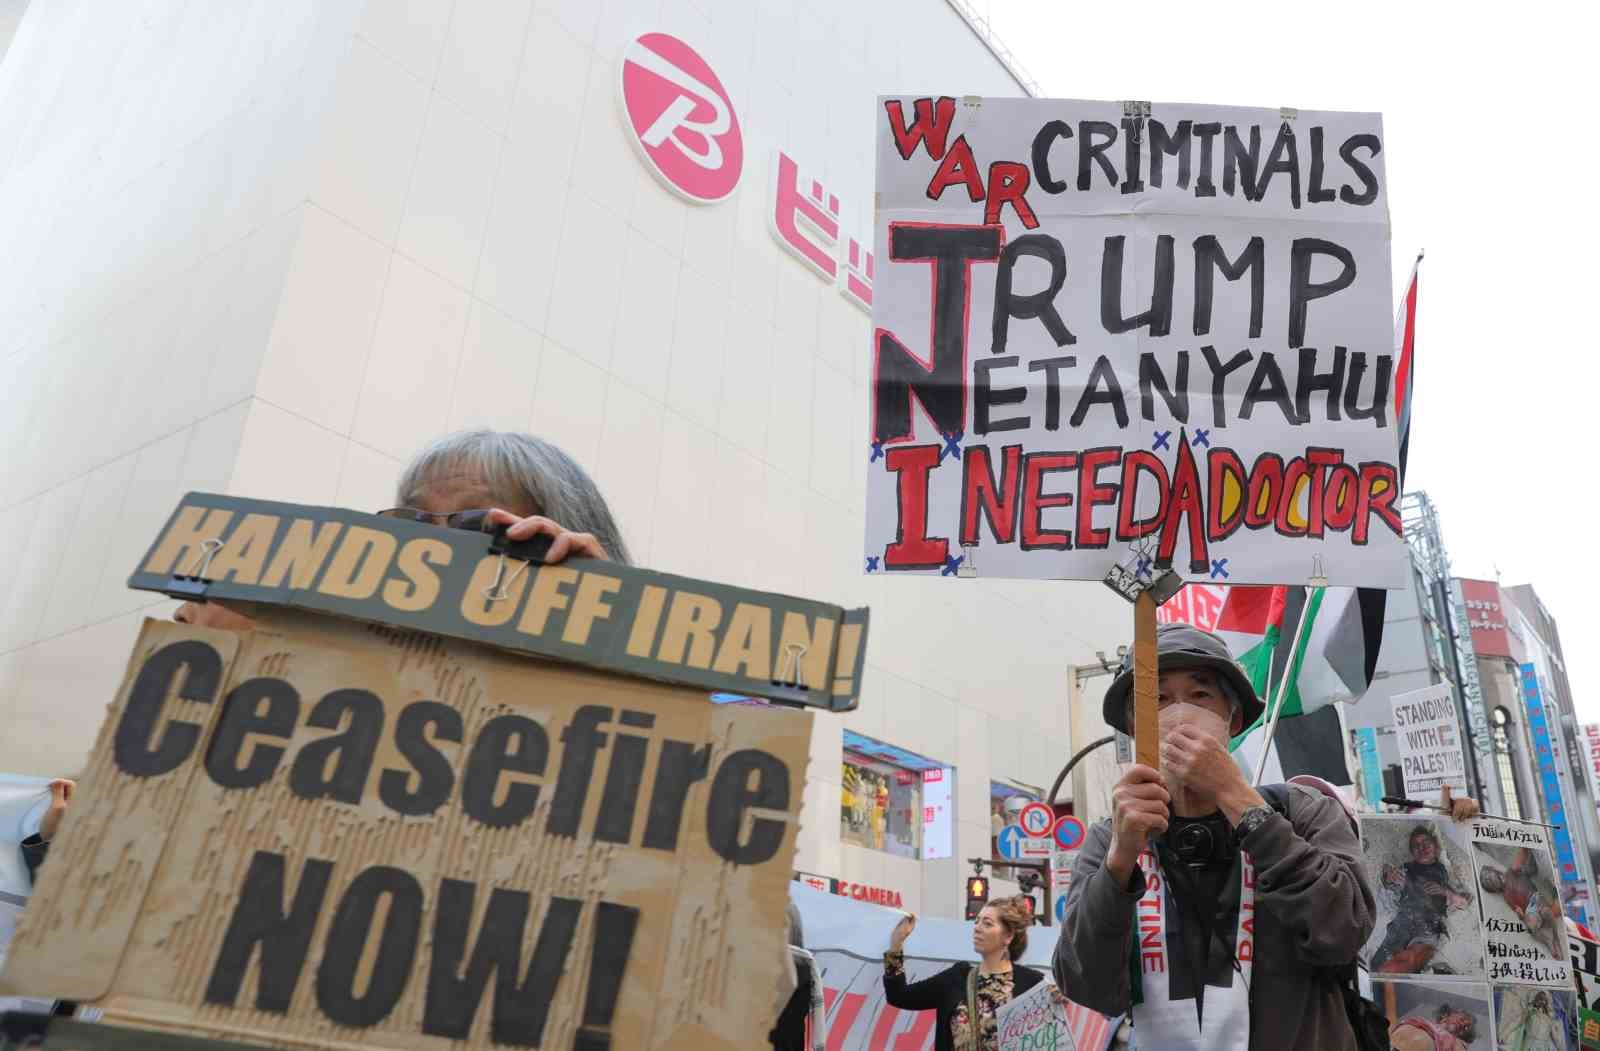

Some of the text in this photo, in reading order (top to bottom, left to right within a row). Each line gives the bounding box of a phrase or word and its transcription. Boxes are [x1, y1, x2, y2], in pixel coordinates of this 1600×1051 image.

[884, 96, 1382, 230] WAR CRIMINALS
[888, 222, 1357, 353] TRUMP
[874, 328, 1393, 443] NETANYAHU
[885, 427, 1403, 574] I NEED A DOCTOR
[144, 505, 858, 697] HANDS OFF IRAN!
[113, 640, 792, 867] Ceasefire
[1395, 696, 1454, 727] STANDING
[1404, 750, 1462, 777] PALESTINE
[1406, 728, 1438, 750] WITH
[205, 851, 641, 1051] NOW!
[850, 883, 903, 908] CAMERA
